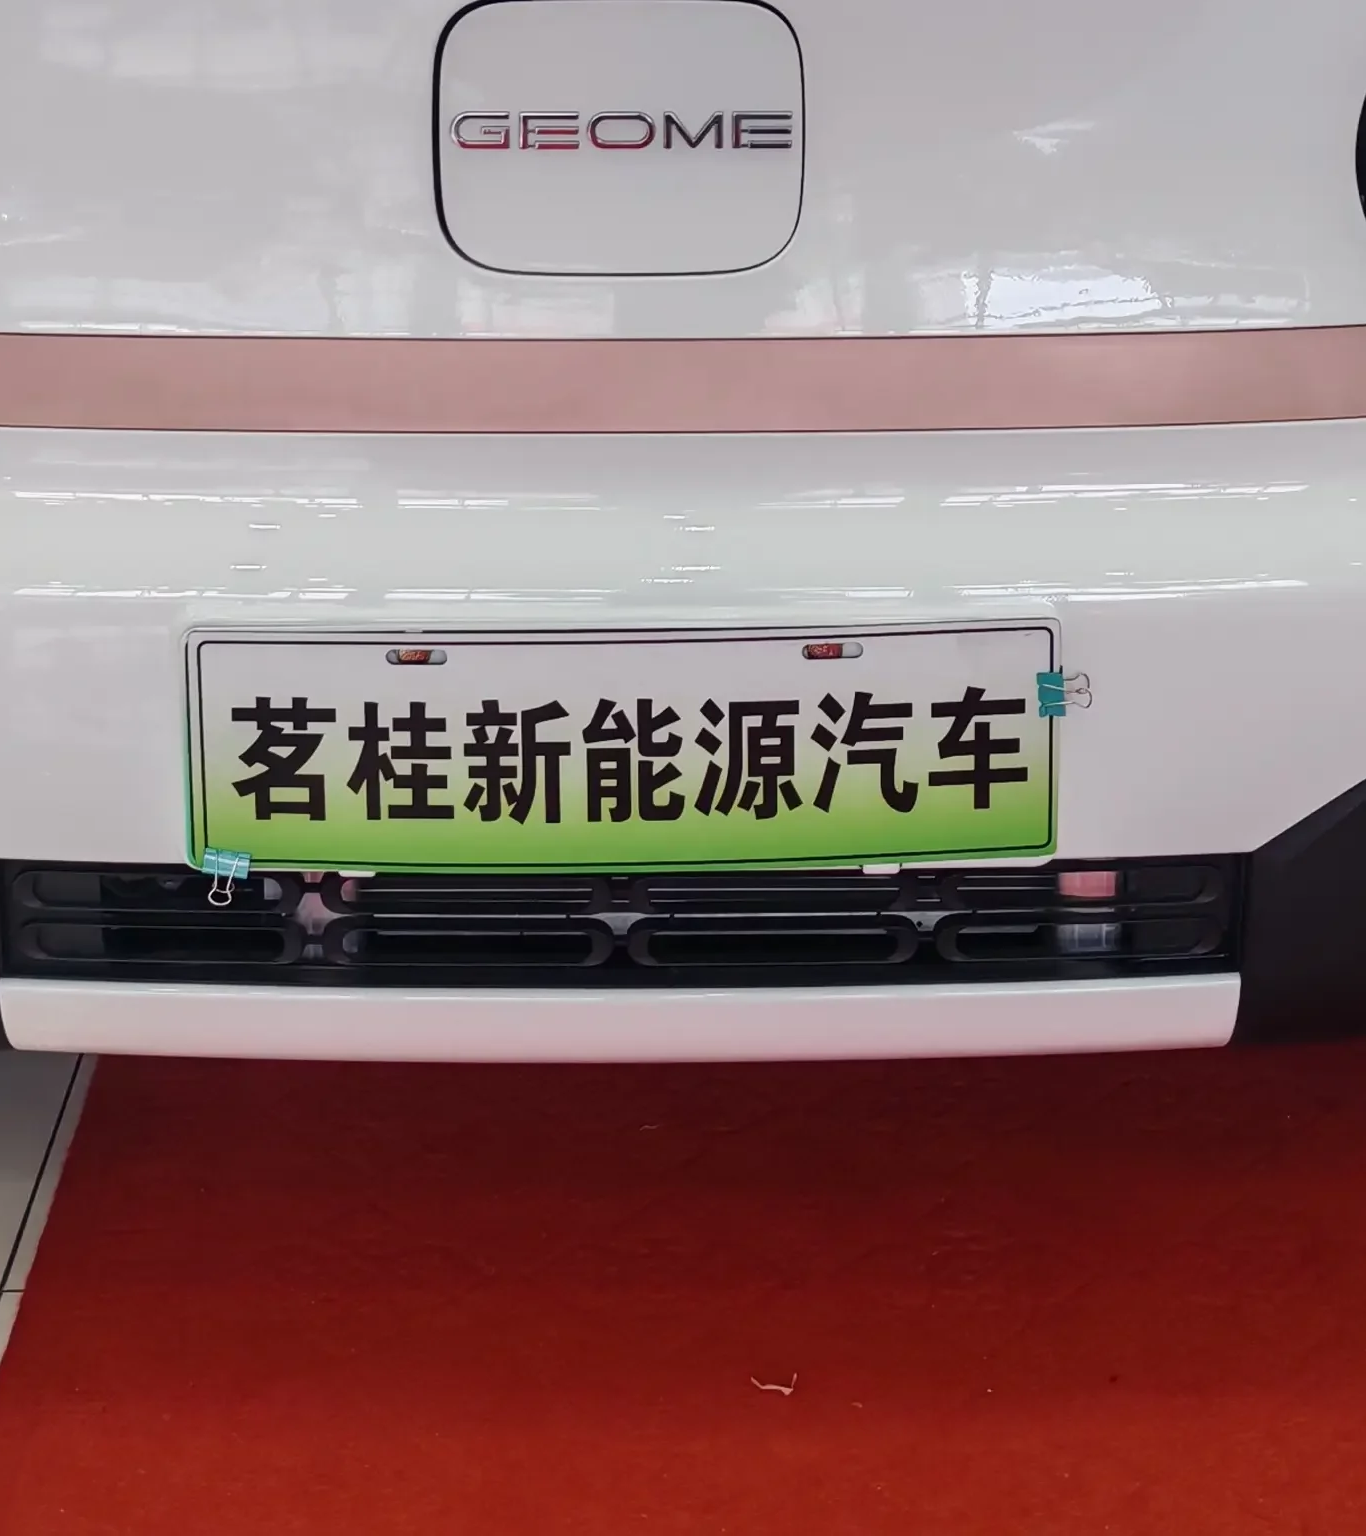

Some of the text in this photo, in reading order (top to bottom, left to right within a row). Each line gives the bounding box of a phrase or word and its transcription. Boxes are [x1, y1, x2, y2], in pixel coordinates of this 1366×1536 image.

[449, 110, 793, 150] GEOME
[230, 686, 1030, 825] 茗桂新能源汽车
